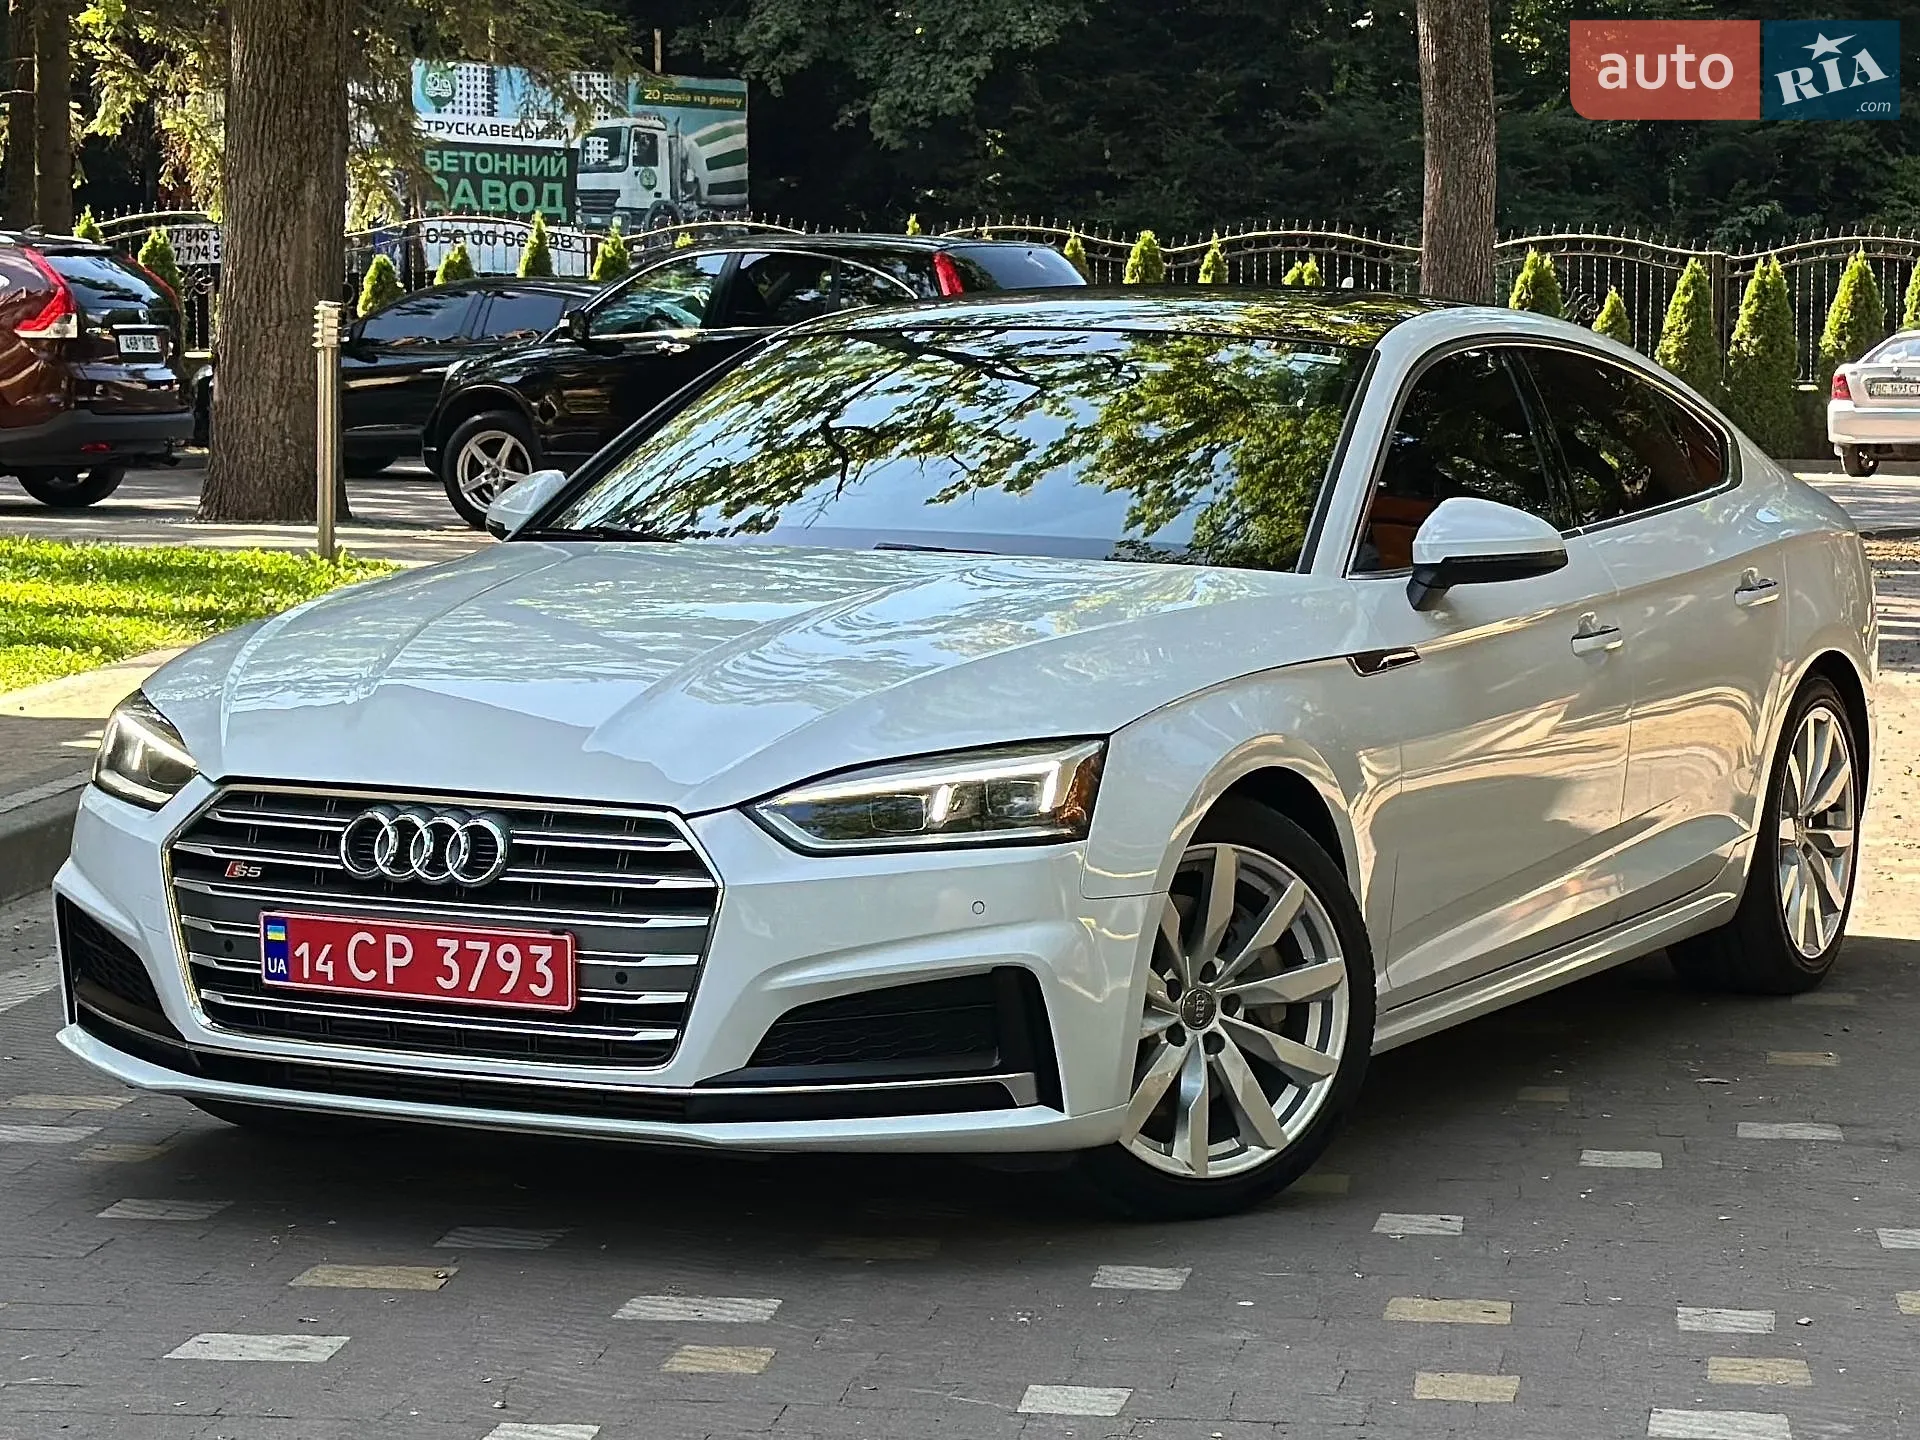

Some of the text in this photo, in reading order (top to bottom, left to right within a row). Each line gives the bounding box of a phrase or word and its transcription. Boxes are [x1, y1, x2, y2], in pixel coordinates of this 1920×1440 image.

[643, 88, 661, 100] 20
[693, 94, 706, 104] на
[424, 149, 568, 178] БЕТОННИЙ
[267, 956, 287, 975] UA
[293, 930, 555, 998] 14 CP 3793
